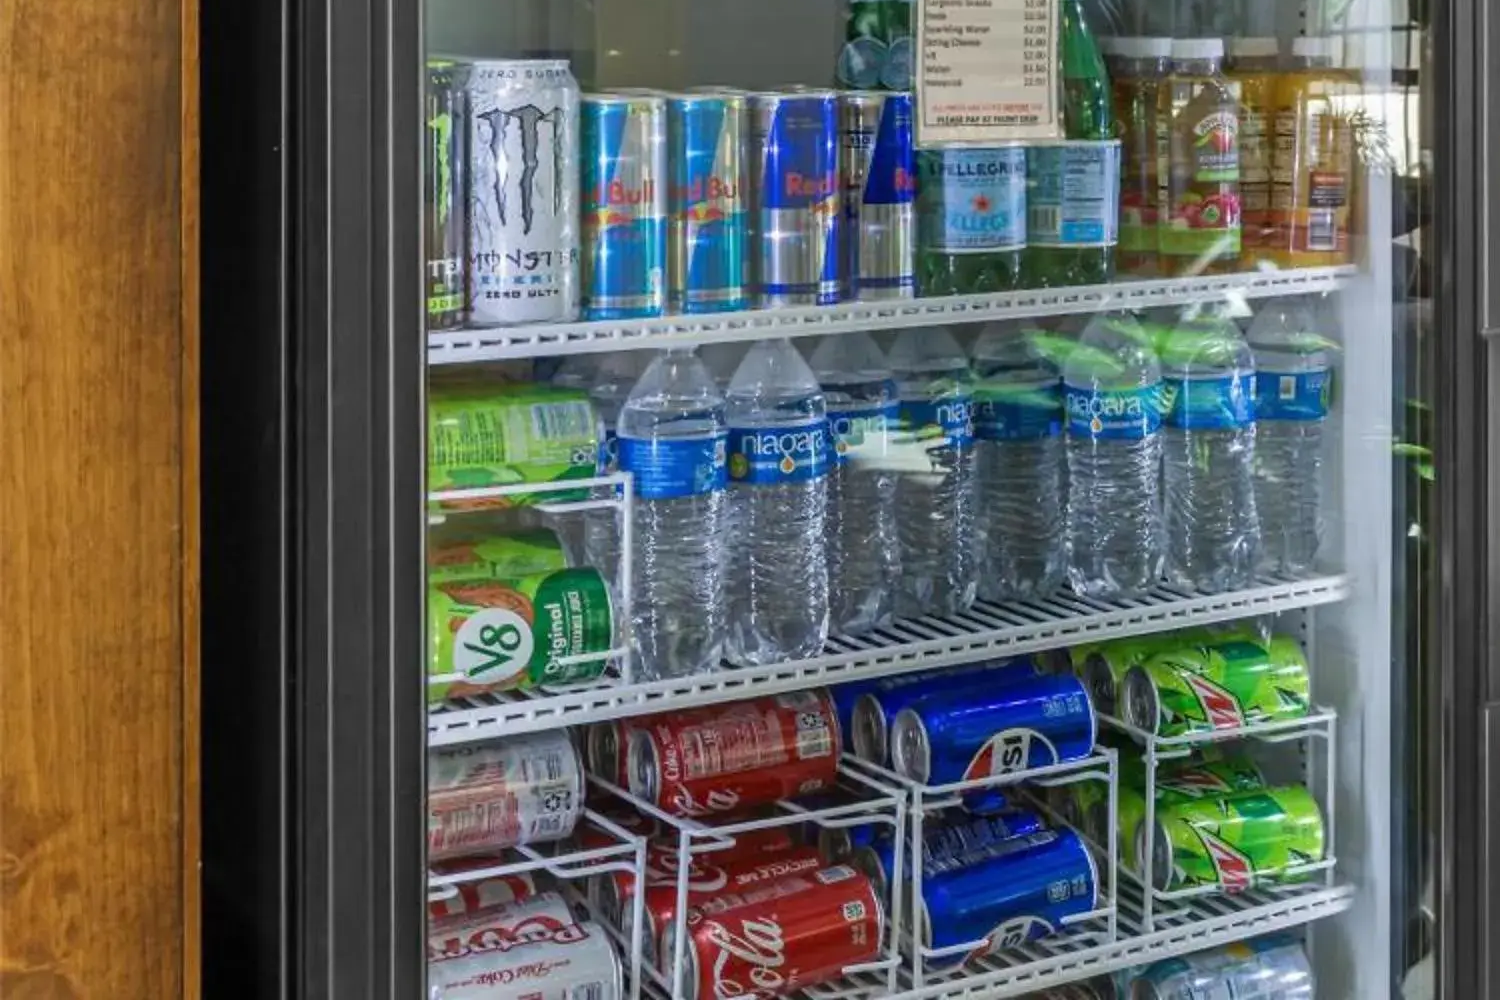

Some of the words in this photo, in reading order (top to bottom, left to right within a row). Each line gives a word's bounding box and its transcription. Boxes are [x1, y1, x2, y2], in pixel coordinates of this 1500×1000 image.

[741, 428, 826, 458] niagara
[463, 623, 522, 677] V8
[544, 602, 568, 674] Original
